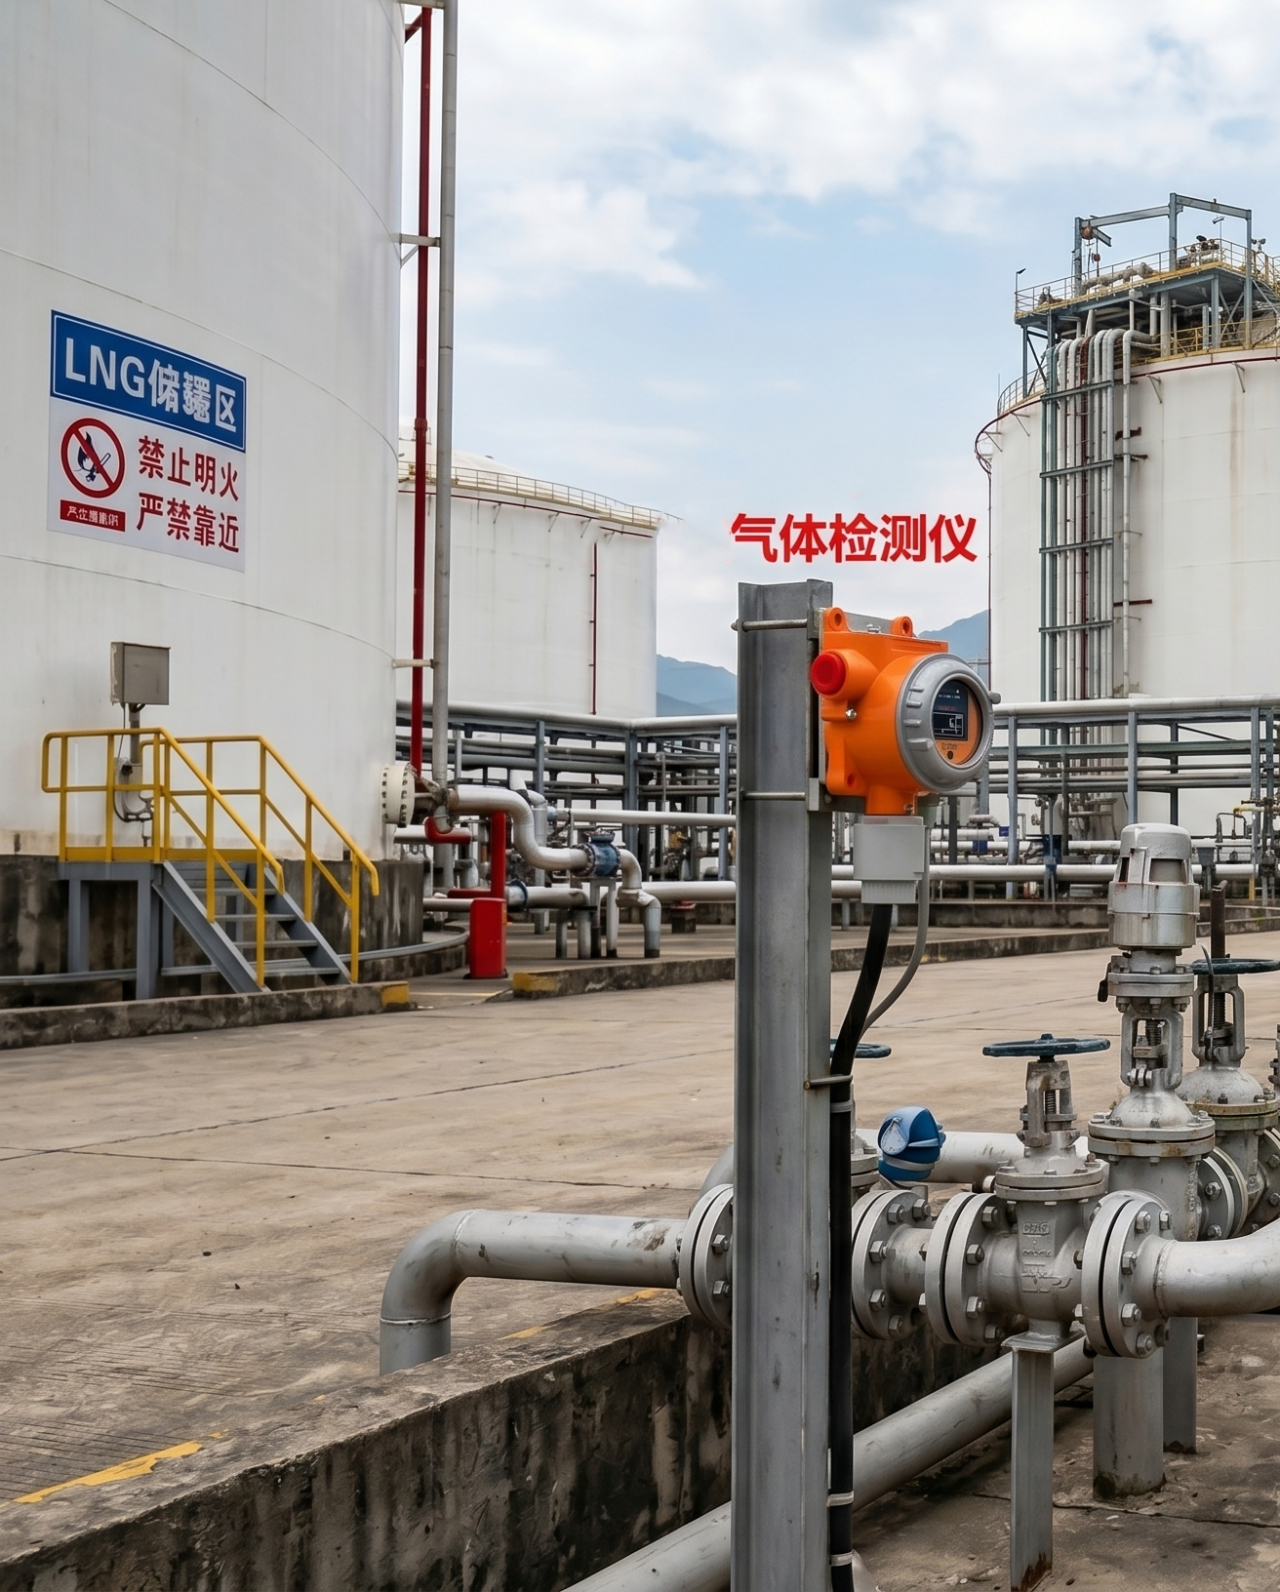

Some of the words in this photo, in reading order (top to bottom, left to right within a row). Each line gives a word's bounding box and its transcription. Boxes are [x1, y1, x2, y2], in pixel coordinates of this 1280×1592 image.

[138, 435, 239, 502] 禁止明火
[136, 492, 239, 553] 严禁靠近
